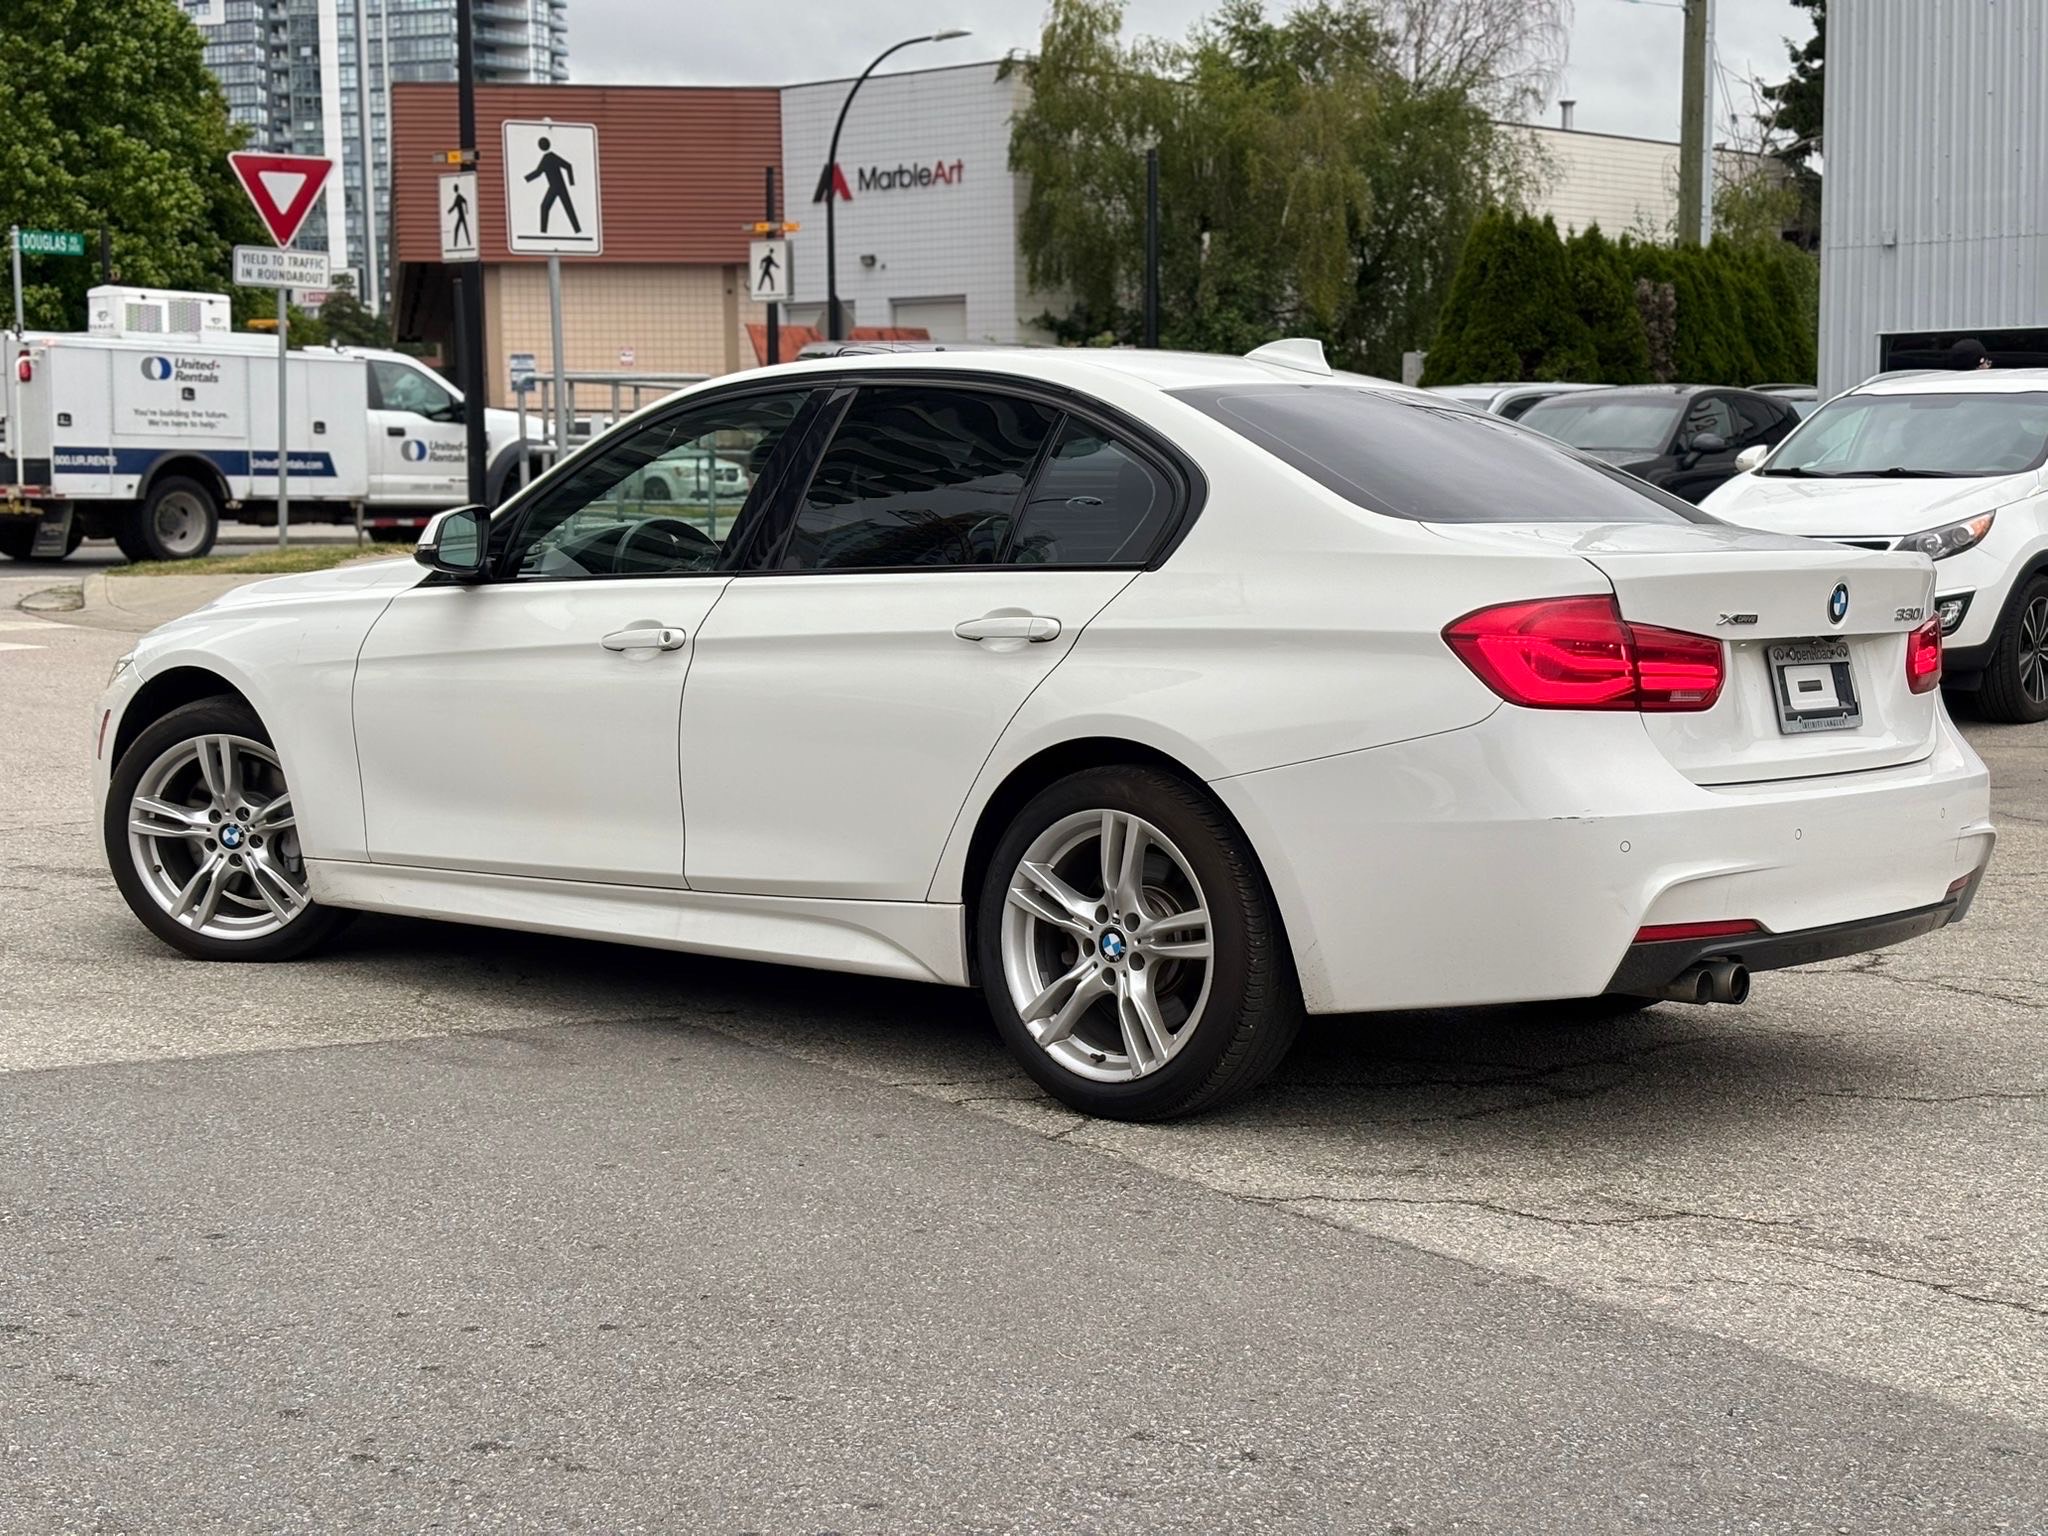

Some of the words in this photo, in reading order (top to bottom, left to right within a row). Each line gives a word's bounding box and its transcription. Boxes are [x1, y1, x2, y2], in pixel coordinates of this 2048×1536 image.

[858, 158, 964, 192] MarbleArt
[22, 233, 67, 252] DOUGLAS
[241, 252, 268, 265] YIELD
[272, 254, 285, 266] TO
[288, 256, 325, 270] TRAFFIC
[241, 267, 253, 279] IN
[257, 268, 324, 284] ROUNDABOUT
[174, 358, 216, 371] United
[174, 370, 219, 383] Rentals
[159, 409, 190, 419] building
[191, 410, 203, 418] the
[190, 420, 198, 428] to
[428, 439, 464, 452] United
[428, 451, 466, 462] Rentals
[1894, 607, 1925, 621] 330i
